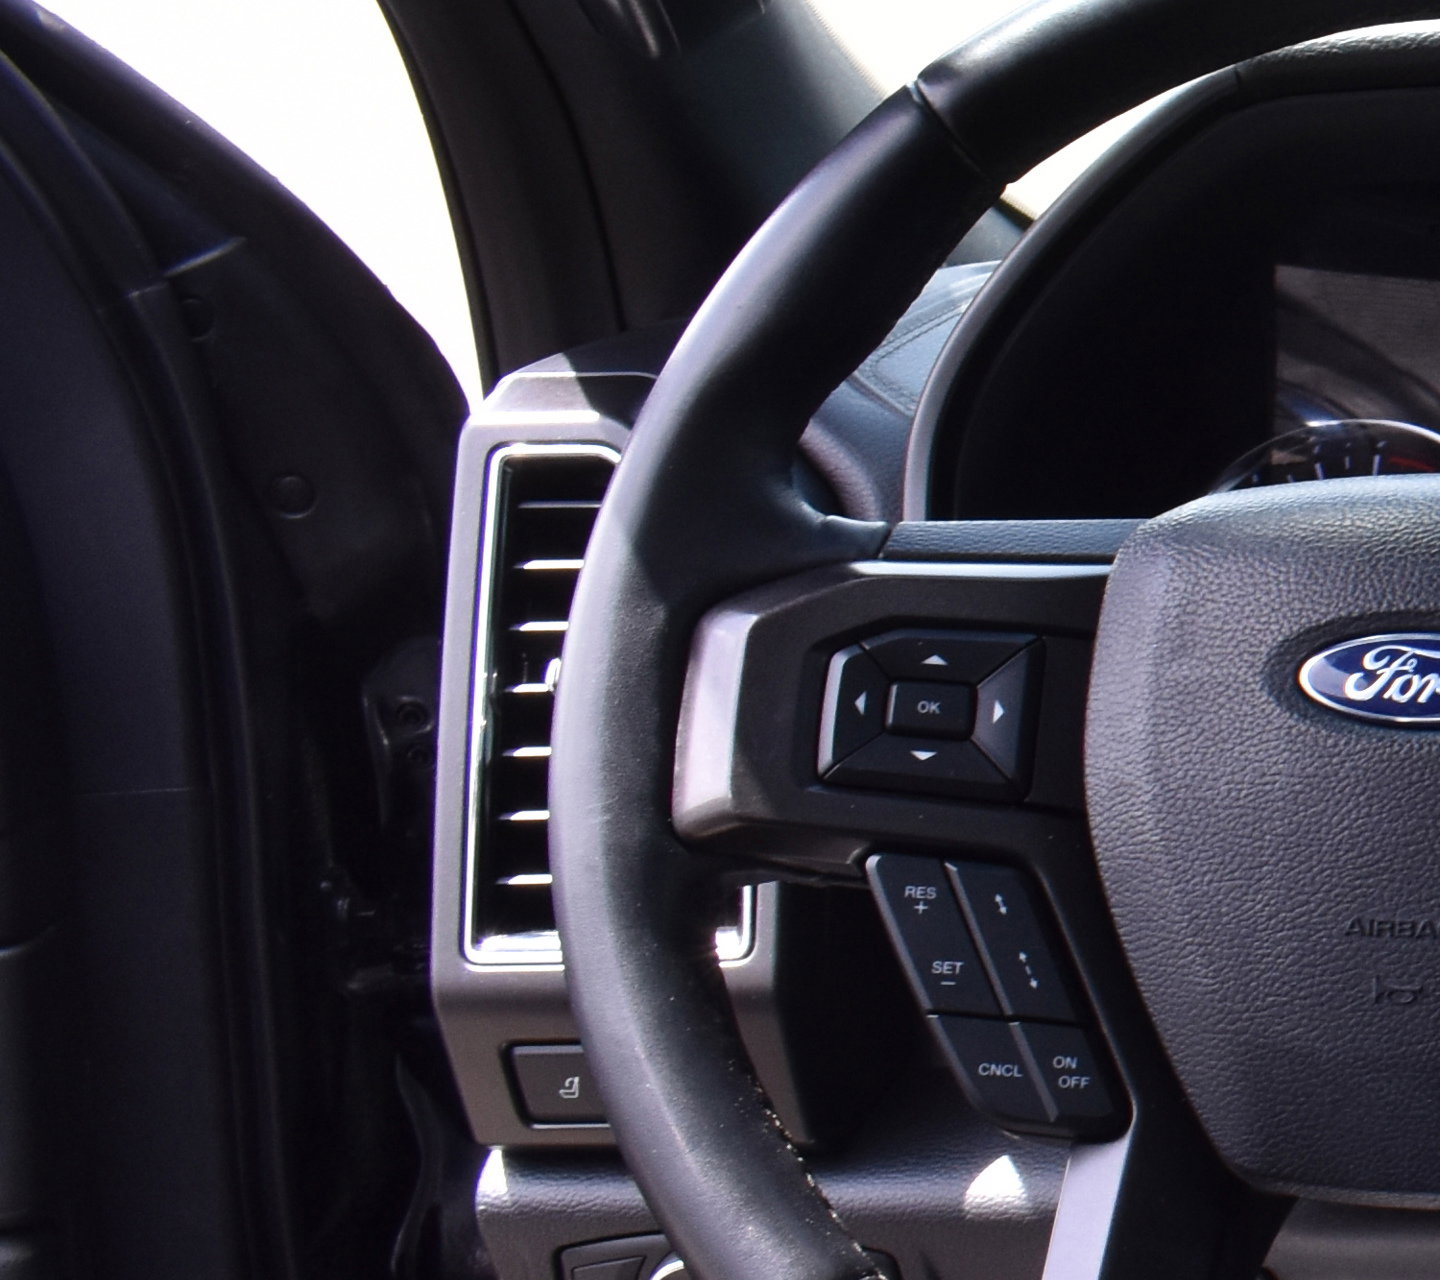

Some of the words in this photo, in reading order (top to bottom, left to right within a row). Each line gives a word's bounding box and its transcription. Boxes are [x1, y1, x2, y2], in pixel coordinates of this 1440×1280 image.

[917, 700, 940, 715] OK
[904, 885, 937, 901] RES
[931, 961, 964, 976] SET
[1053, 1055, 1078, 1069] ON
[978, 1063, 1024, 1078] CNCL
[1058, 1074, 1091, 1090] OFF
